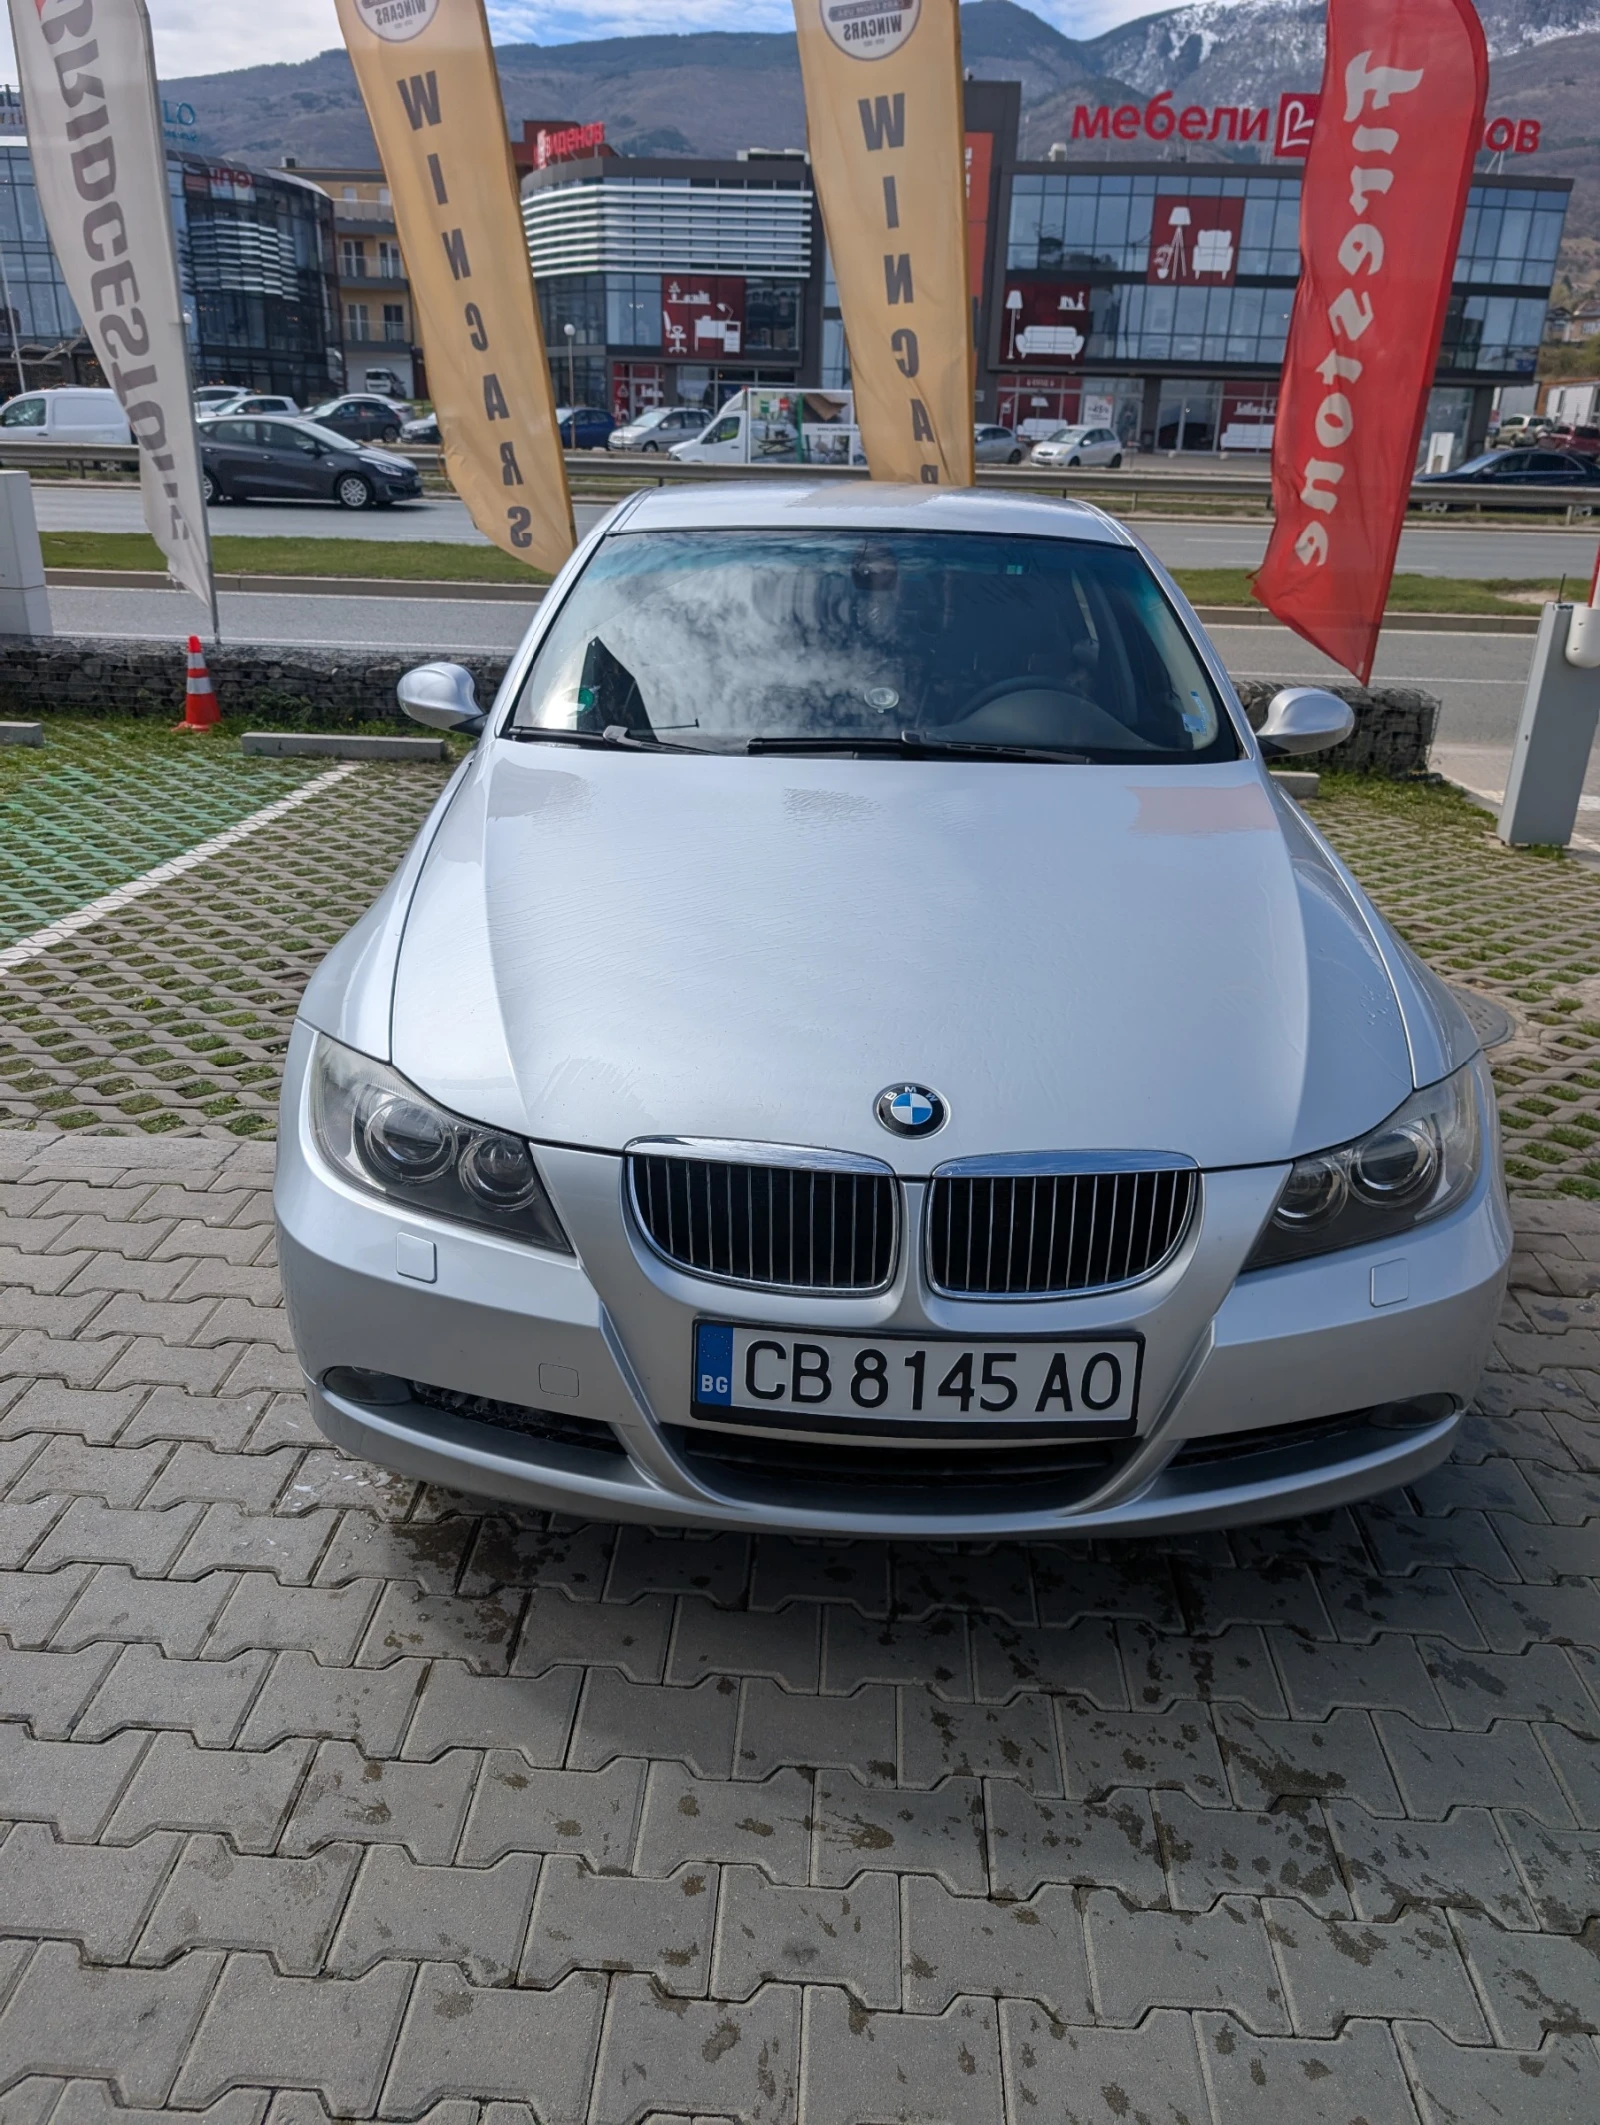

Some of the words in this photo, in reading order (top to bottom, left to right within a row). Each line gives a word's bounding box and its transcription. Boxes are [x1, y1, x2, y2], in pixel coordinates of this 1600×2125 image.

[1070, 90, 1270, 141] мебели
[884, 1086, 939, 1102] BMW
[701, 1374, 729, 1394] BG
[745, 1339, 833, 1404] CB
[849, 1347, 1019, 1413] 8145
